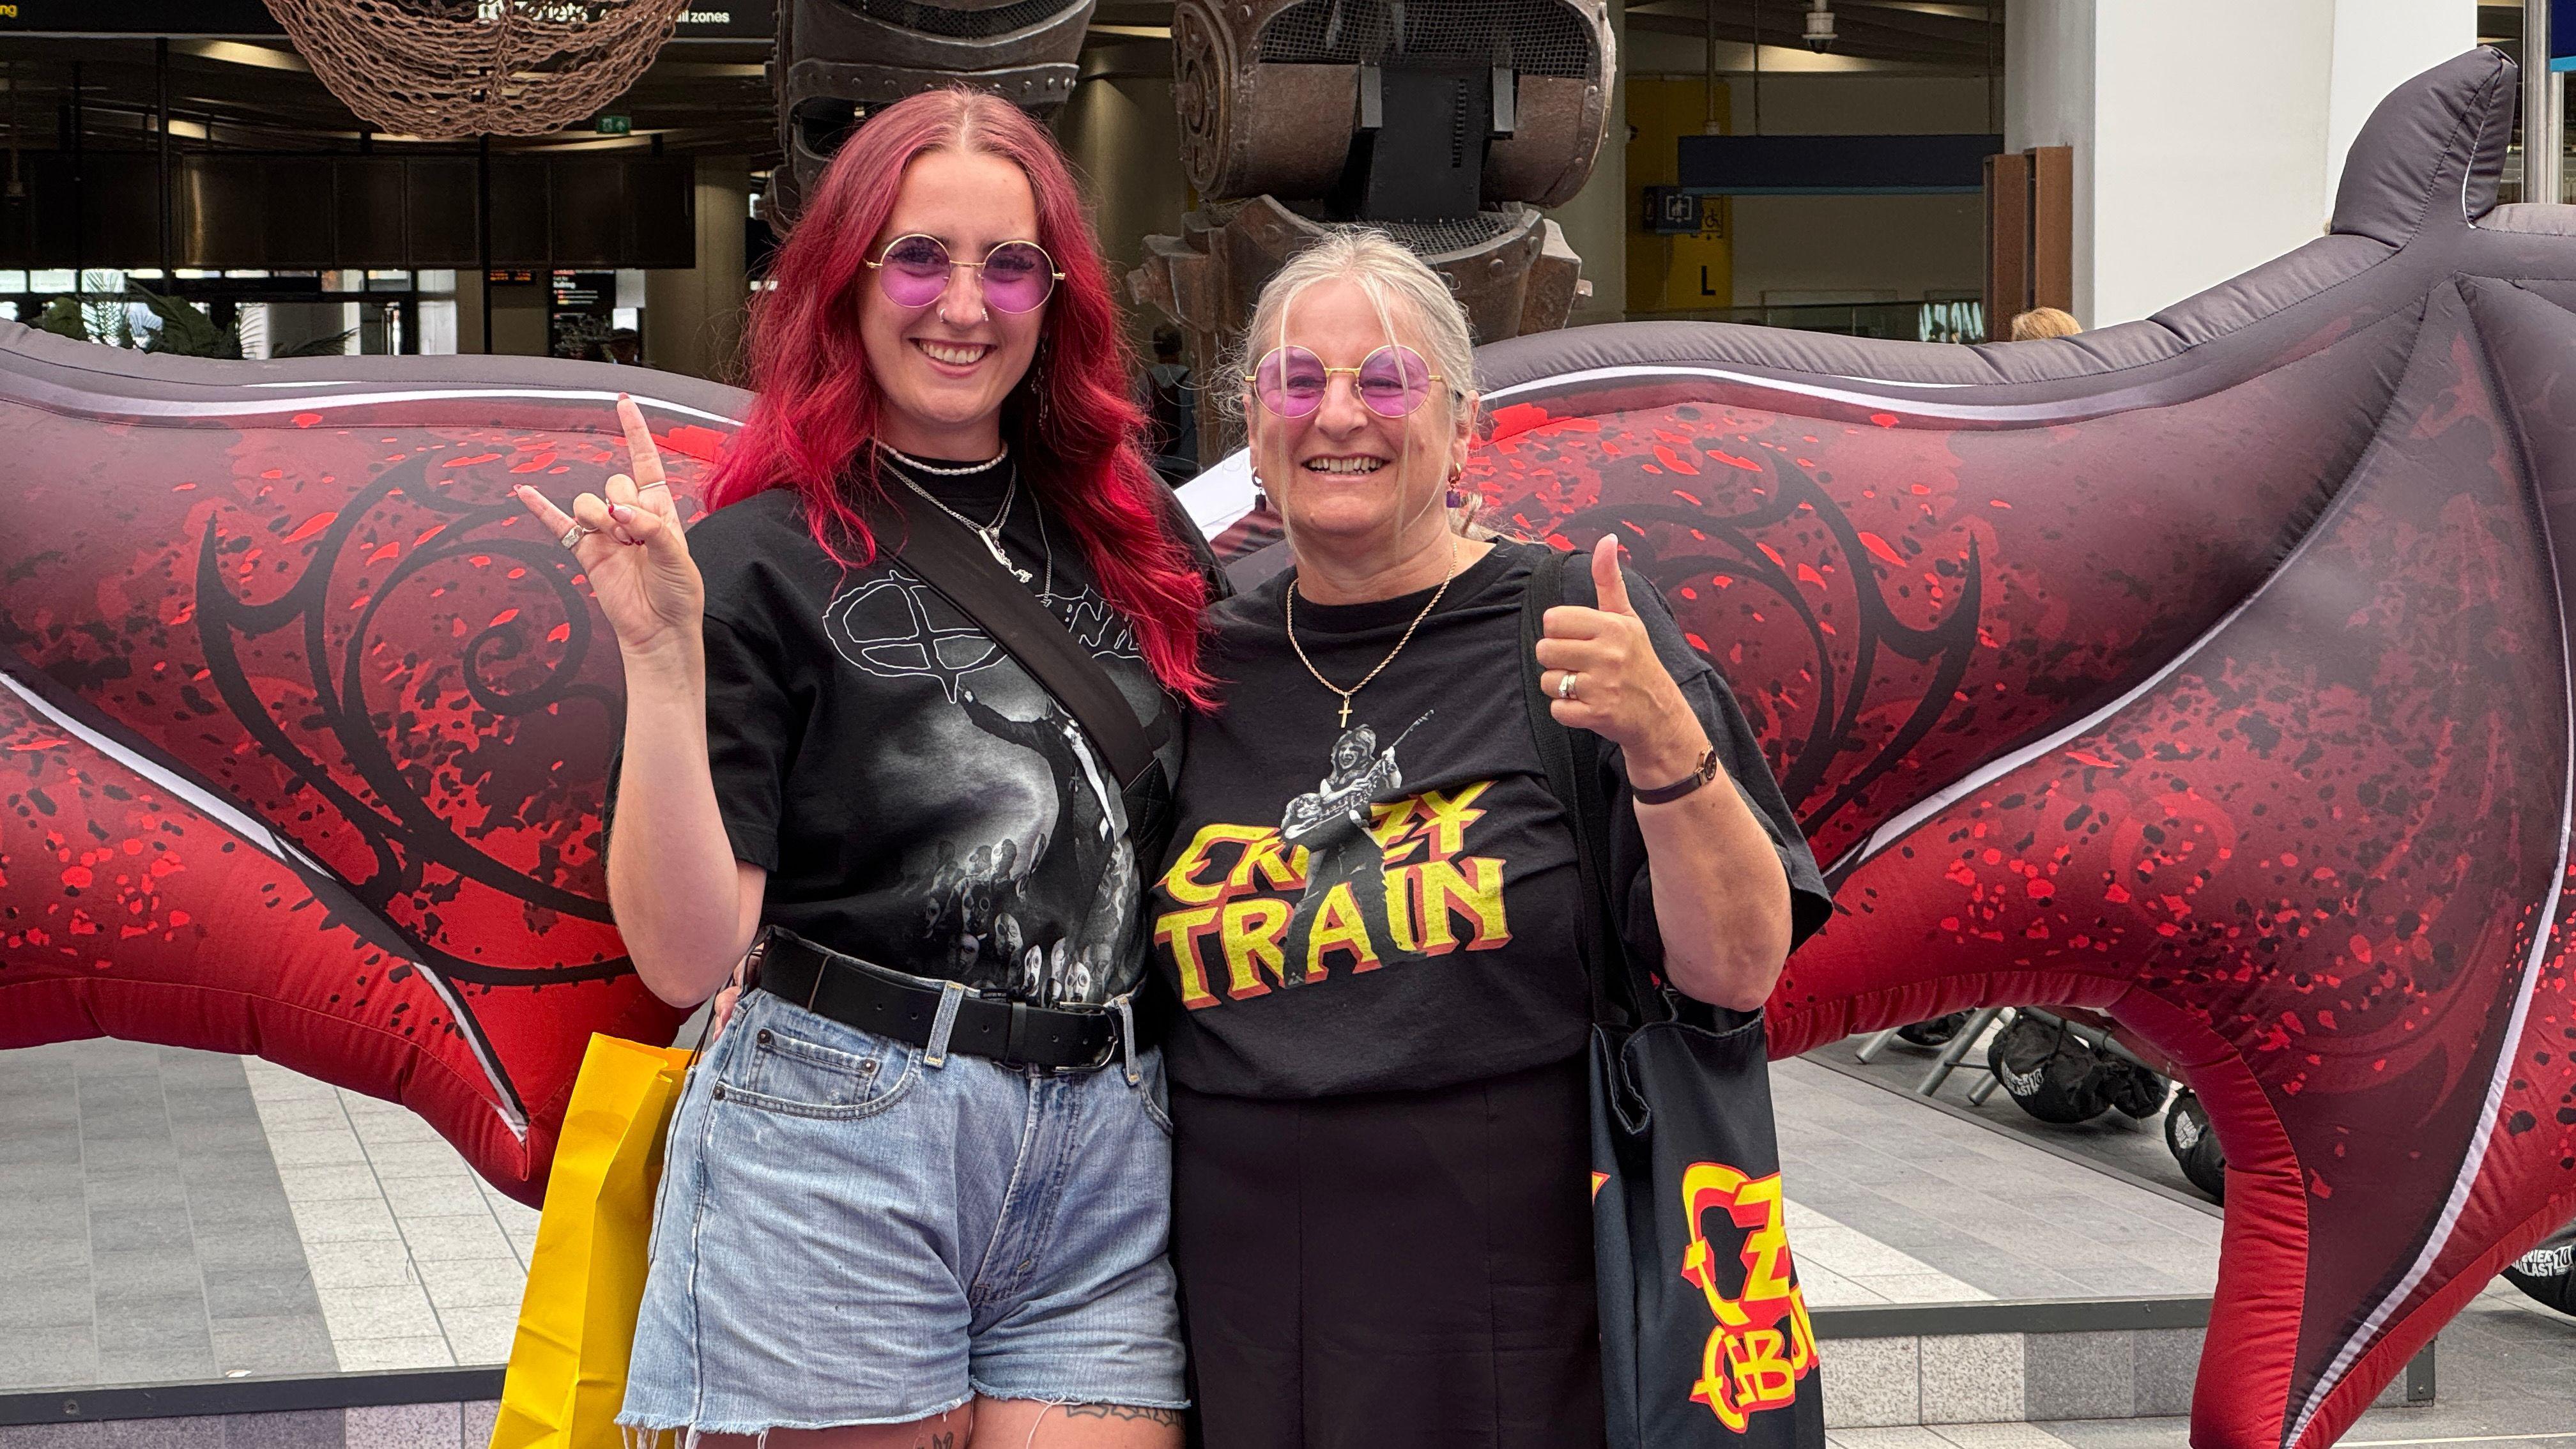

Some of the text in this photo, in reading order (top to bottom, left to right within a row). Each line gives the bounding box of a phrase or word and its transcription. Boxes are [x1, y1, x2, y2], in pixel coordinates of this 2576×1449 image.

[691, 12, 730, 23] zones
[1701, 265, 1716, 296] L
[1154, 856, 1514, 1010] TRAIN
[2511, 1260, 2554, 1278] ALLAST
